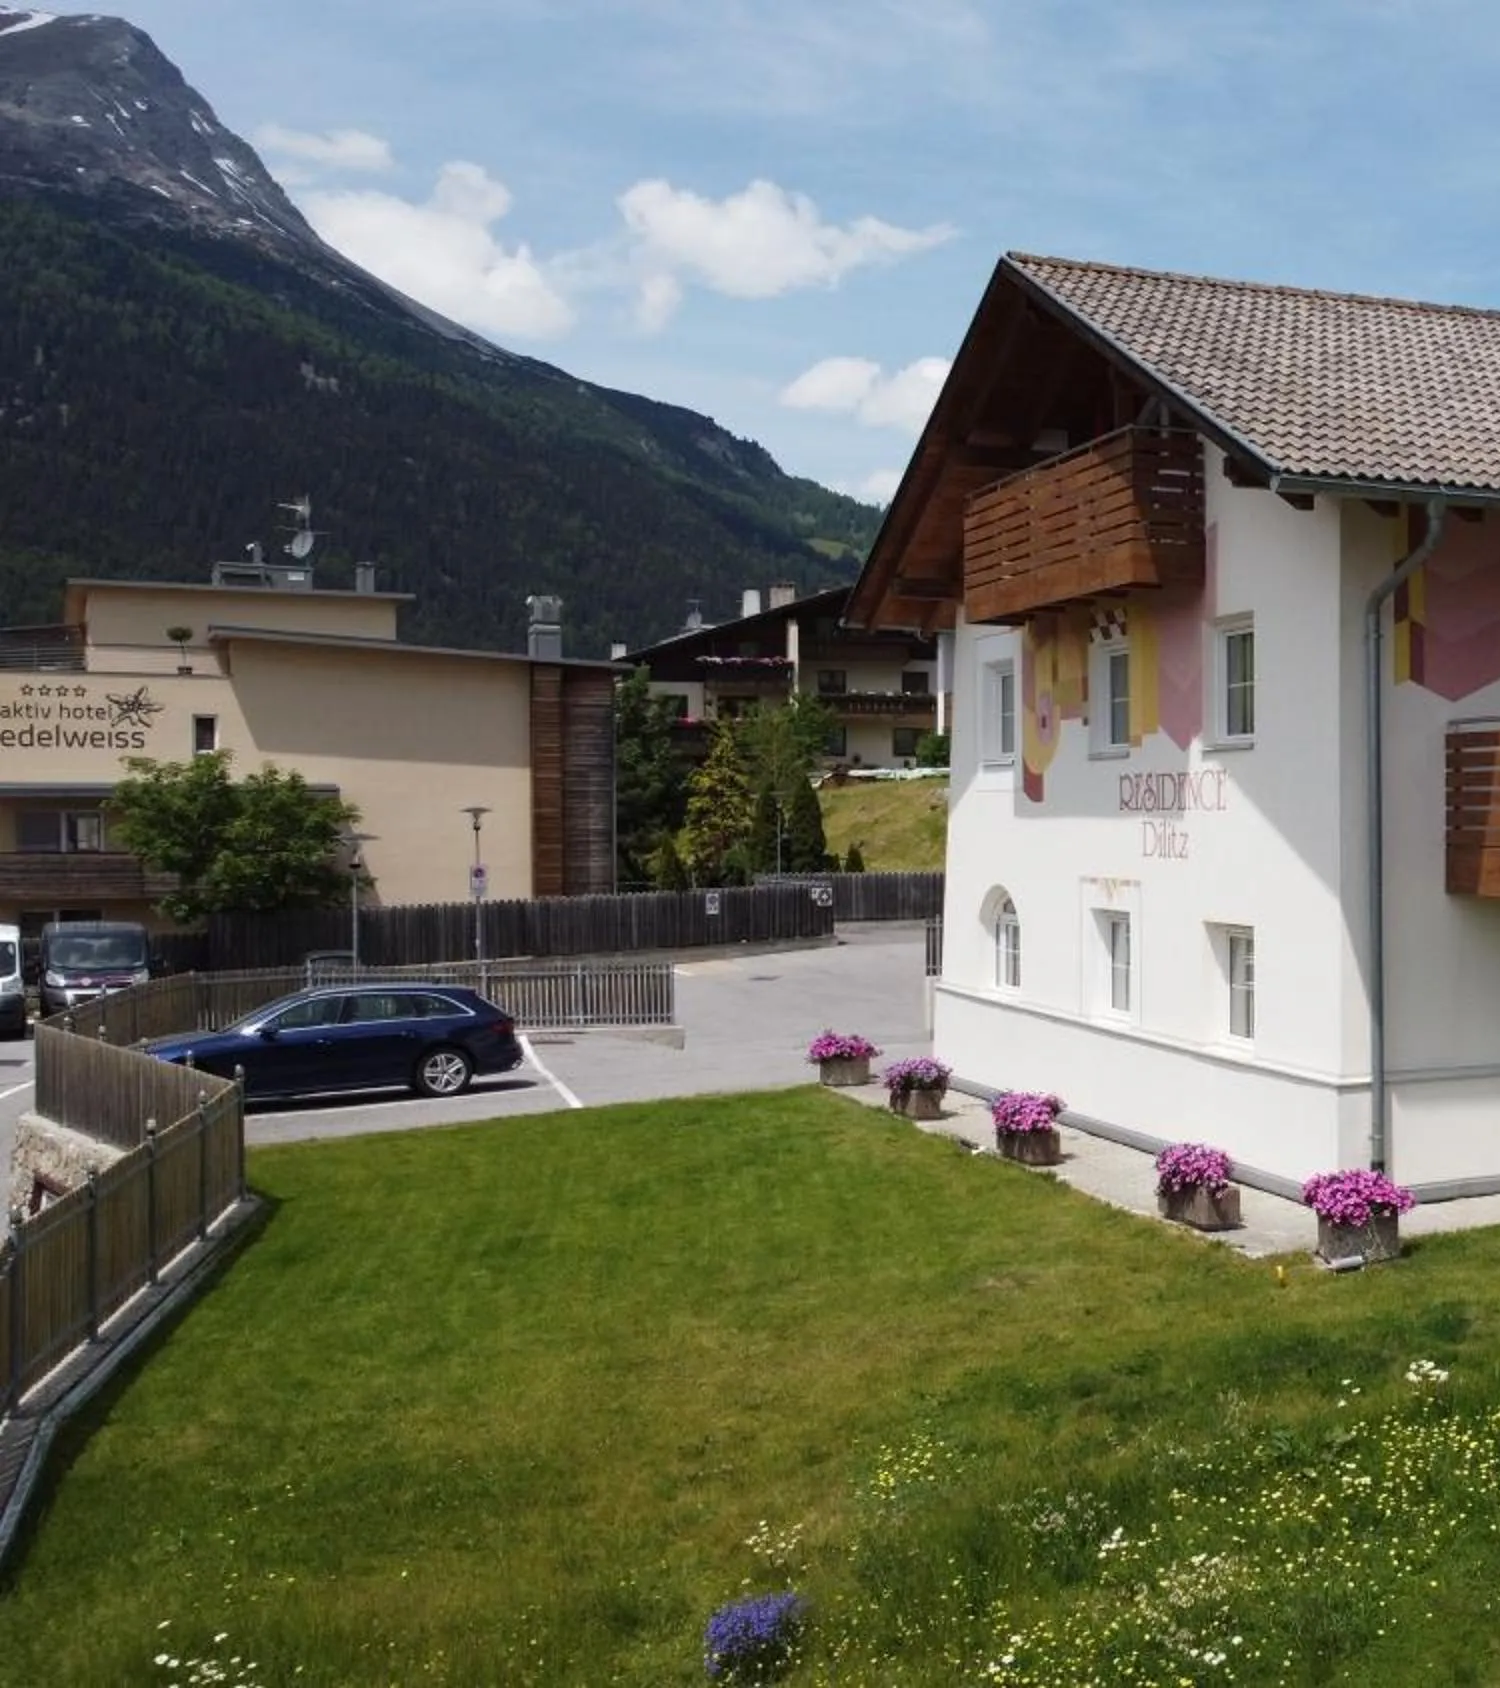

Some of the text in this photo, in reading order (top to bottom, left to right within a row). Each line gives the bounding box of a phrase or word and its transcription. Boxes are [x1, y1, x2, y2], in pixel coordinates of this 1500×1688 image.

[0, 702, 113, 721] aktiv hotel
[0, 724, 145, 749] edelweiss
[1119, 768, 1227, 812] RESIDENCE
